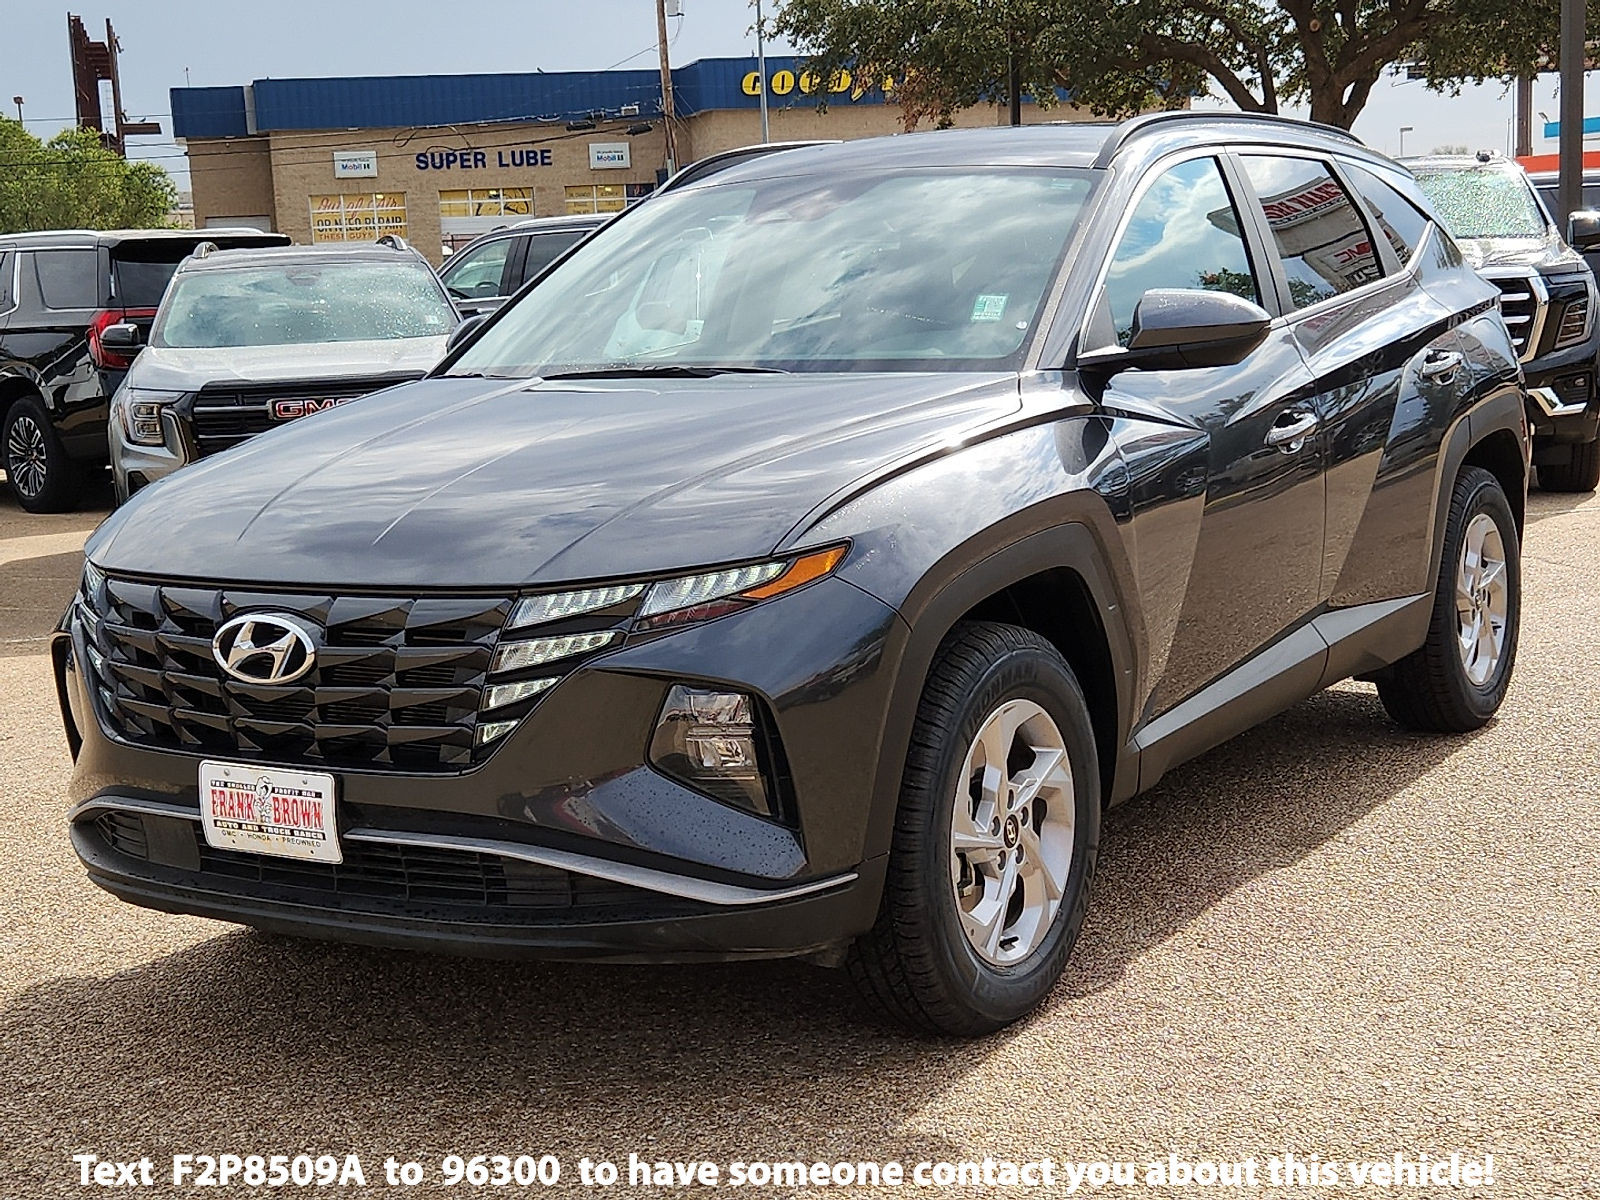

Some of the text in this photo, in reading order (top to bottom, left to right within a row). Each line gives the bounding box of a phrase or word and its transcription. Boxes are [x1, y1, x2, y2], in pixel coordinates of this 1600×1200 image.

[741, 69, 896, 102] GOODY
[415, 149, 553, 170] SUPER LUBE
[317, 216, 403, 232] OR NEED REPAIR
[349, 232, 374, 240] GUYS
[275, 398, 354, 418] GM
[274, 787, 299, 797] PROFIT
[211, 789, 323, 830] FRANK BROWN
[216, 820, 324, 840] AUTO AND TRUCK RANCH
[246, 832, 271, 841] HONDA
[281, 836, 321, 848] PREOWNED
